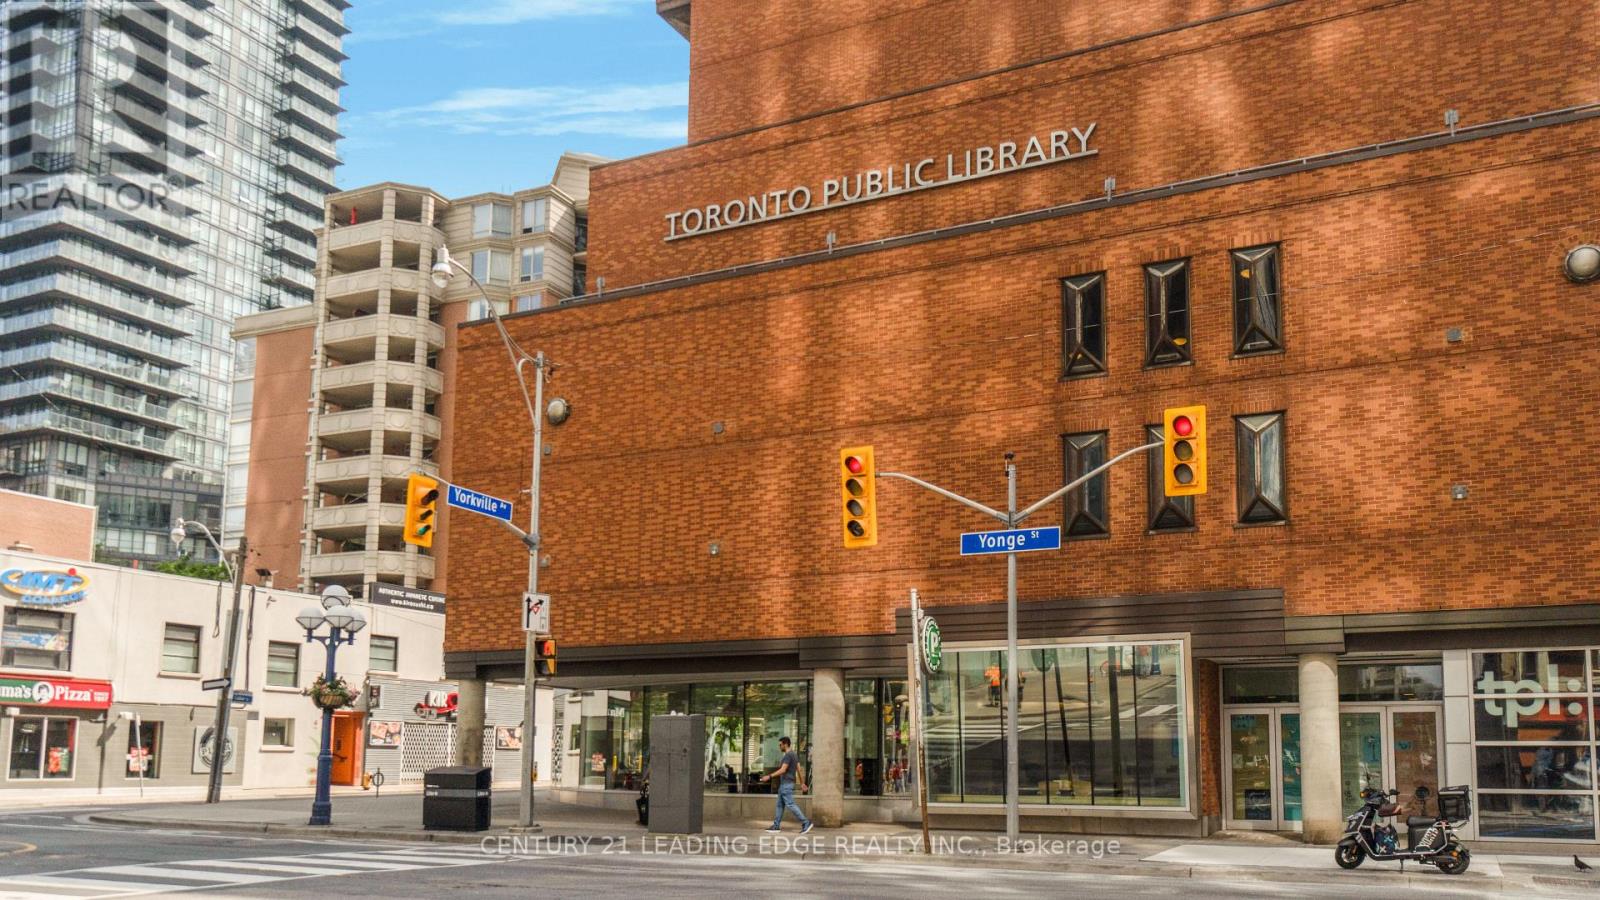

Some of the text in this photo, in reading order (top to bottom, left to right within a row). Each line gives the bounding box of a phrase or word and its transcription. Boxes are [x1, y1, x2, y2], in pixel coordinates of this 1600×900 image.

[664, 122, 1097, 239] TORONTO PUBLIC LIBRARY
[454, 487, 498, 512] Yorkville
[978, 530, 1040, 551] Yonge St
[54, 685, 91, 702] Pizza
